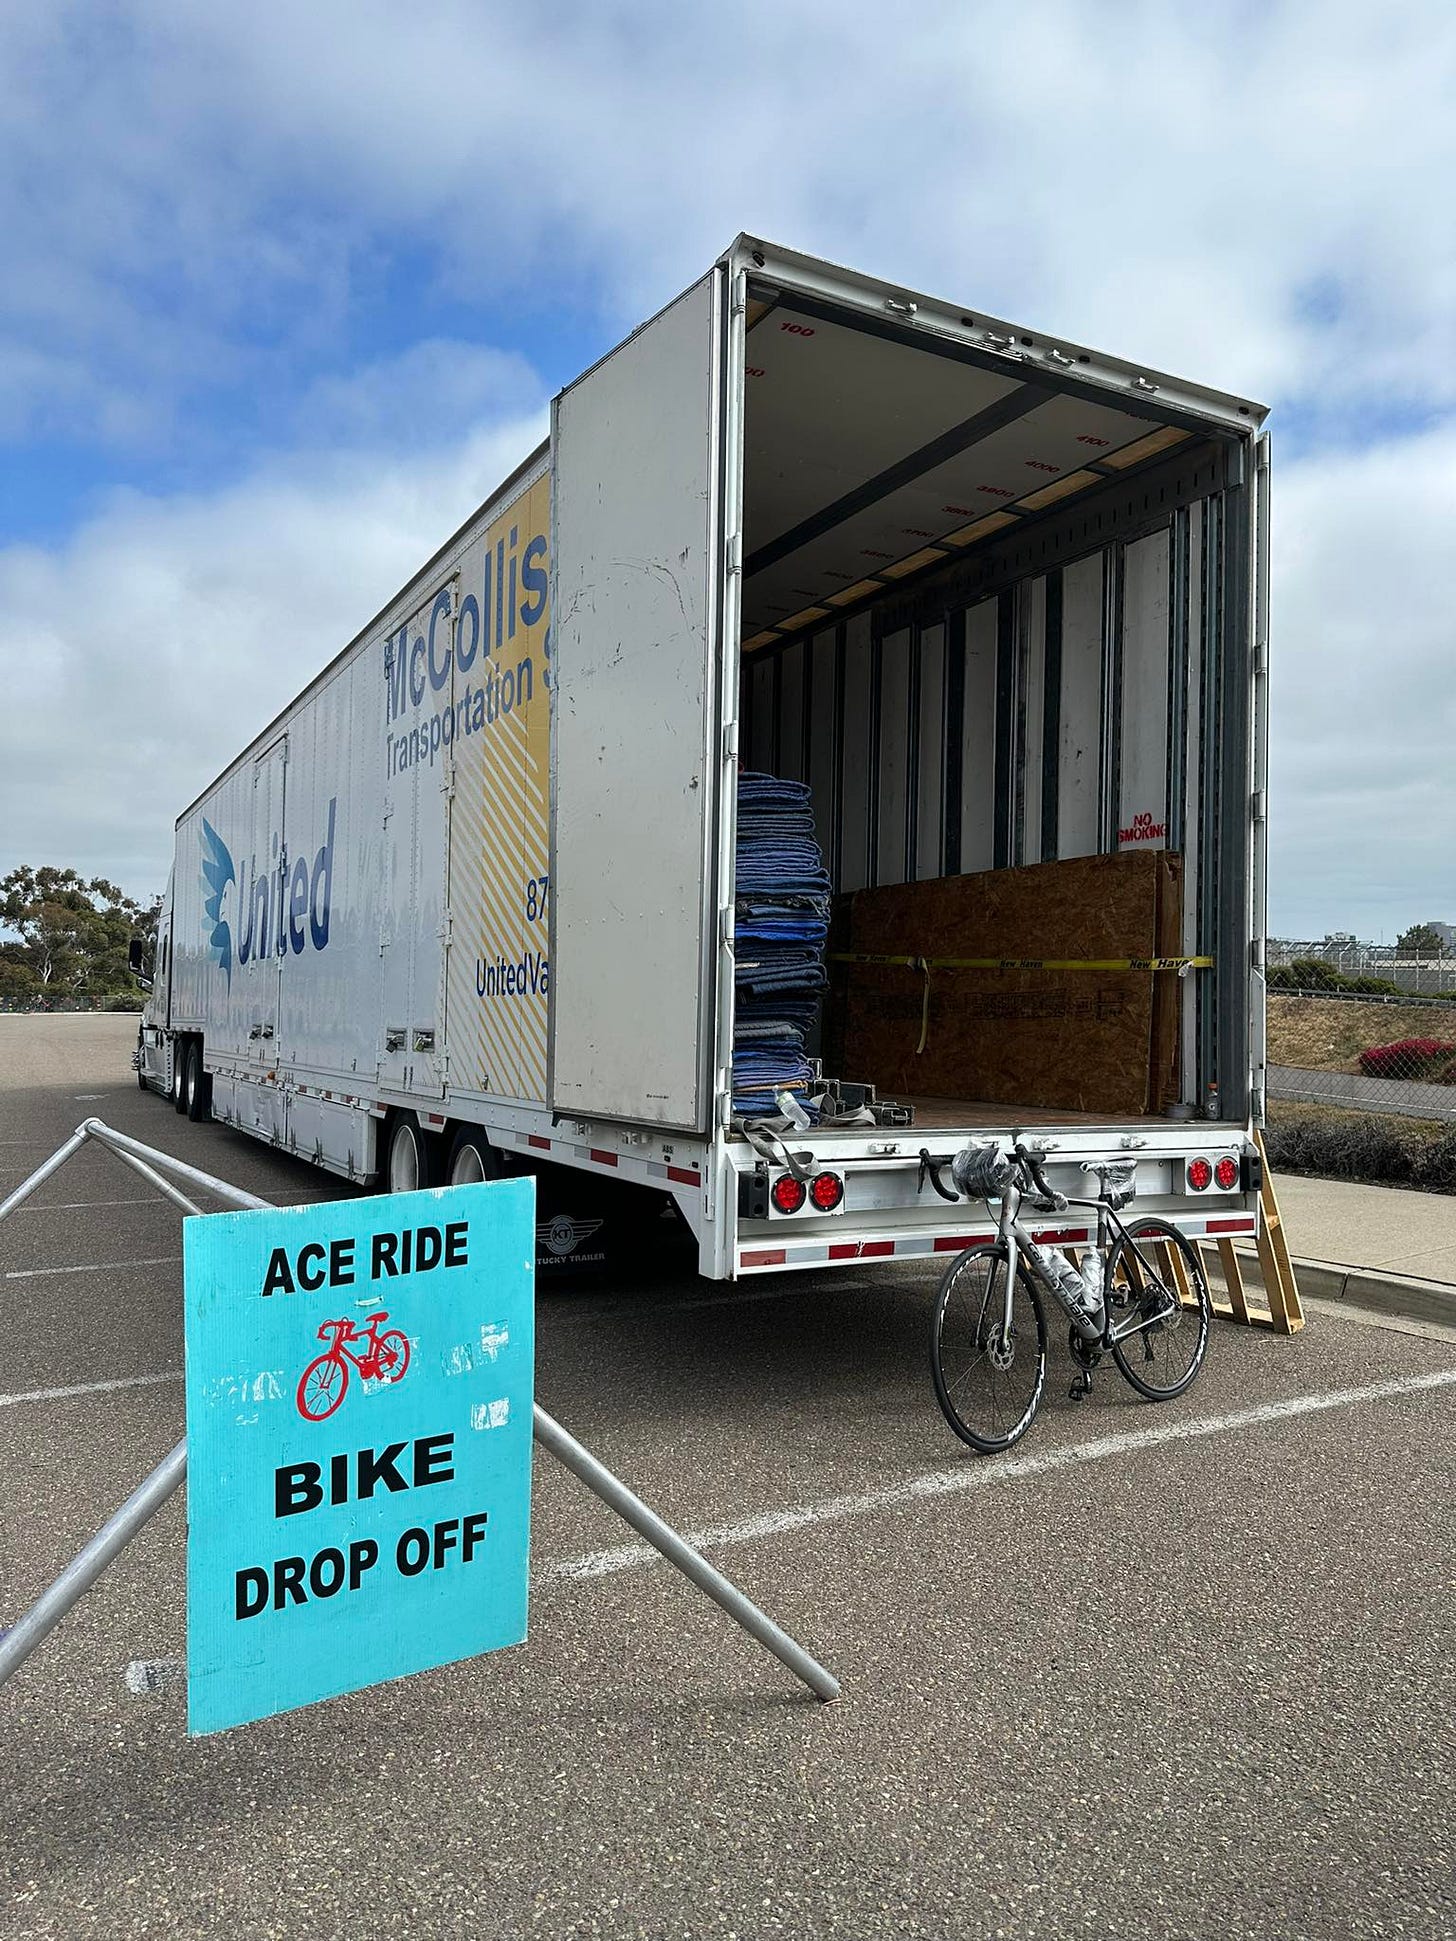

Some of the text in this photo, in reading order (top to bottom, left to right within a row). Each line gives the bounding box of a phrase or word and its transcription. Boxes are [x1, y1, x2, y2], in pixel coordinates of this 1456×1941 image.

[780, 322, 815, 337] 100
[1076, 434, 1111, 448] 4100
[1024, 460, 1061, 473] 4000
[387, 657, 532, 780] Transportation
[1133, 812, 1152, 827] NO
[1117, 823, 1168, 843] SMOKING
[238, 796, 337, 965] United
[526, 876, 548, 921] 87
[1000, 960, 1014, 968] New
[1130, 959, 1192, 968] New Have
[476, 952, 549, 997] UnitedVa
[262, 1221, 469, 1297] ACE RIDE
[569, 1252, 605, 1262] TRAILER
[275, 1432, 455, 1518] BIKE
[235, 1512, 488, 1620] DROP OFF
